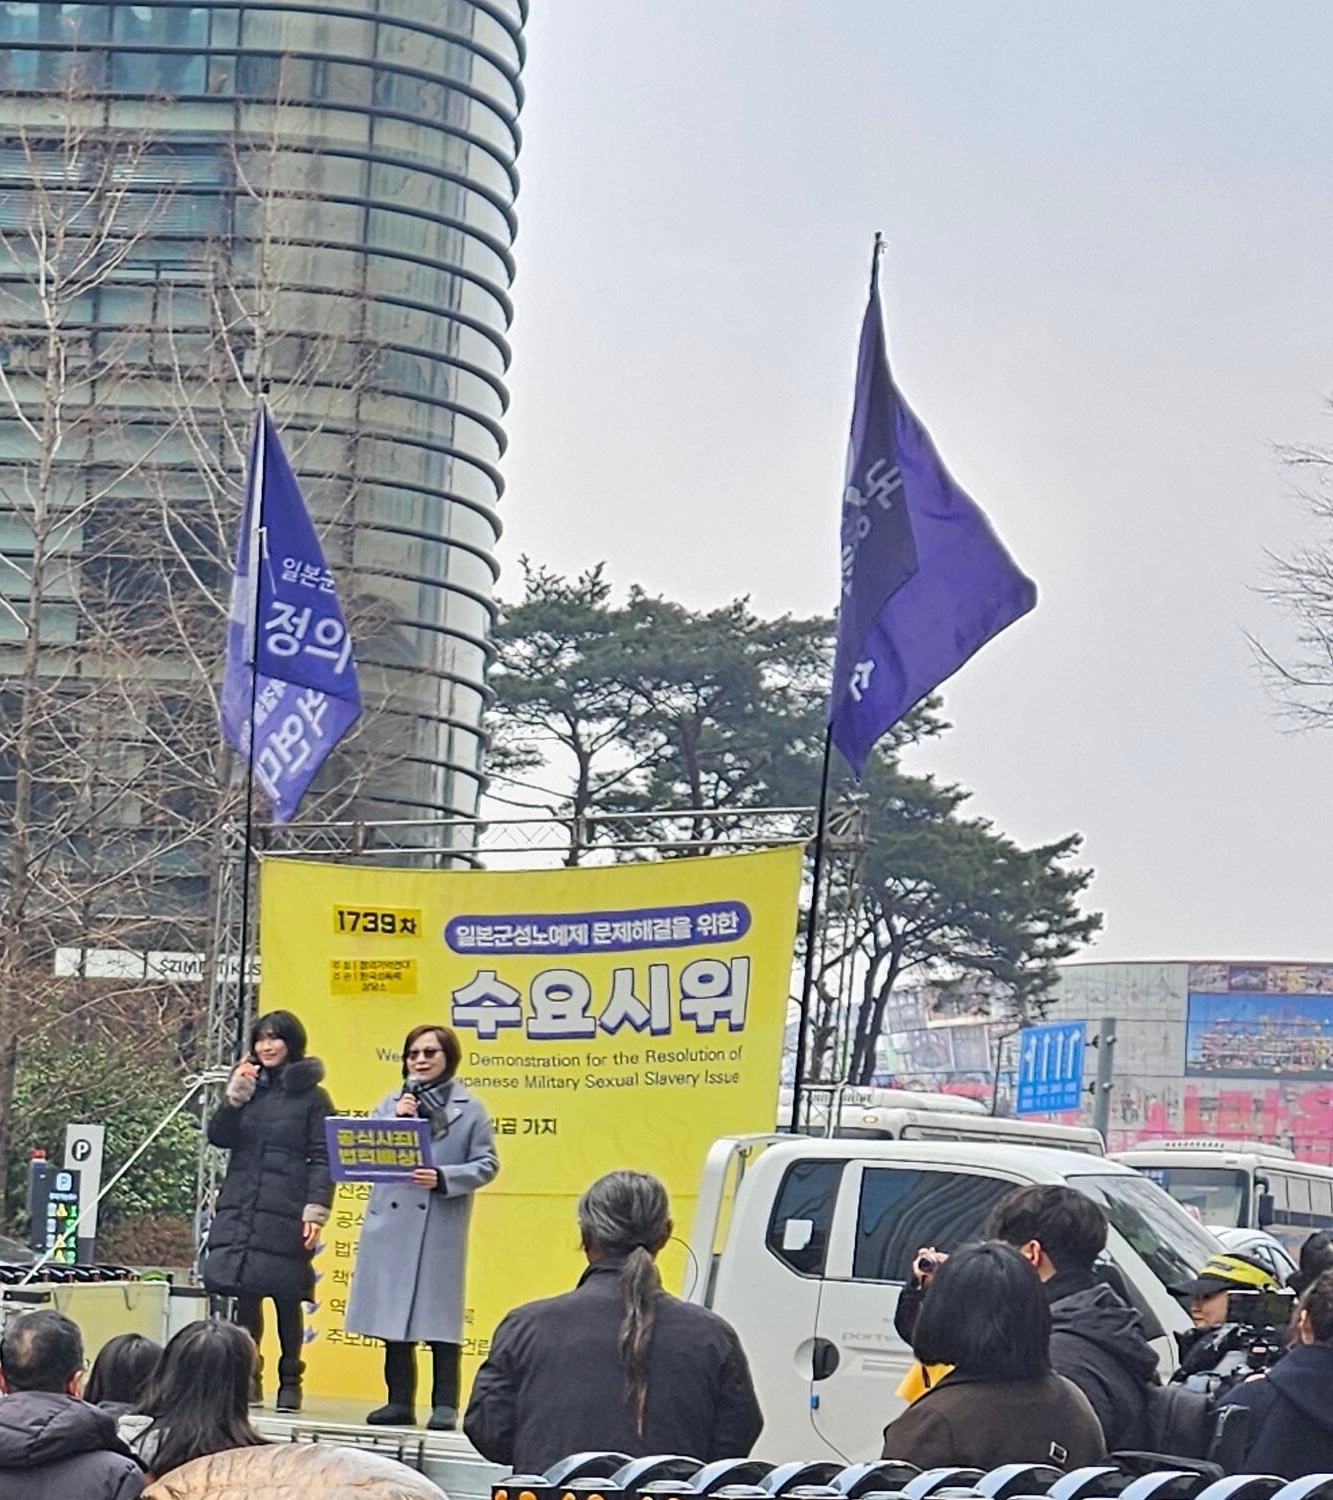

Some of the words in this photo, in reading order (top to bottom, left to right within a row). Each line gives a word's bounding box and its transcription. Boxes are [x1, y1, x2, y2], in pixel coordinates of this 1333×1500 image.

[265, 600, 351, 674] 정의
[337, 909, 418, 935] 1739차
[455, 922, 589, 948] 일본군성노예제
[593, 915, 692, 944] 문제해결을
[696, 910, 741, 936] 위한
[451, 955, 751, 1040] 수요시위
[469, 1051, 580, 1068] Demonstration
[586, 1050, 607, 1066] for
[613, 1049, 639, 1065] the
[646, 1047, 725, 1063] Resolution
[729, 1045, 744, 1061] of
[457, 1076, 519, 1091] apanese
[524, 1074, 581, 1091] Military
[585, 1072, 639, 1089] Sexual
[644, 1070, 700, 1088] Slavery
[704, 1069, 740, 1084] Issue
[523, 1117, 558, 1136] 가지
